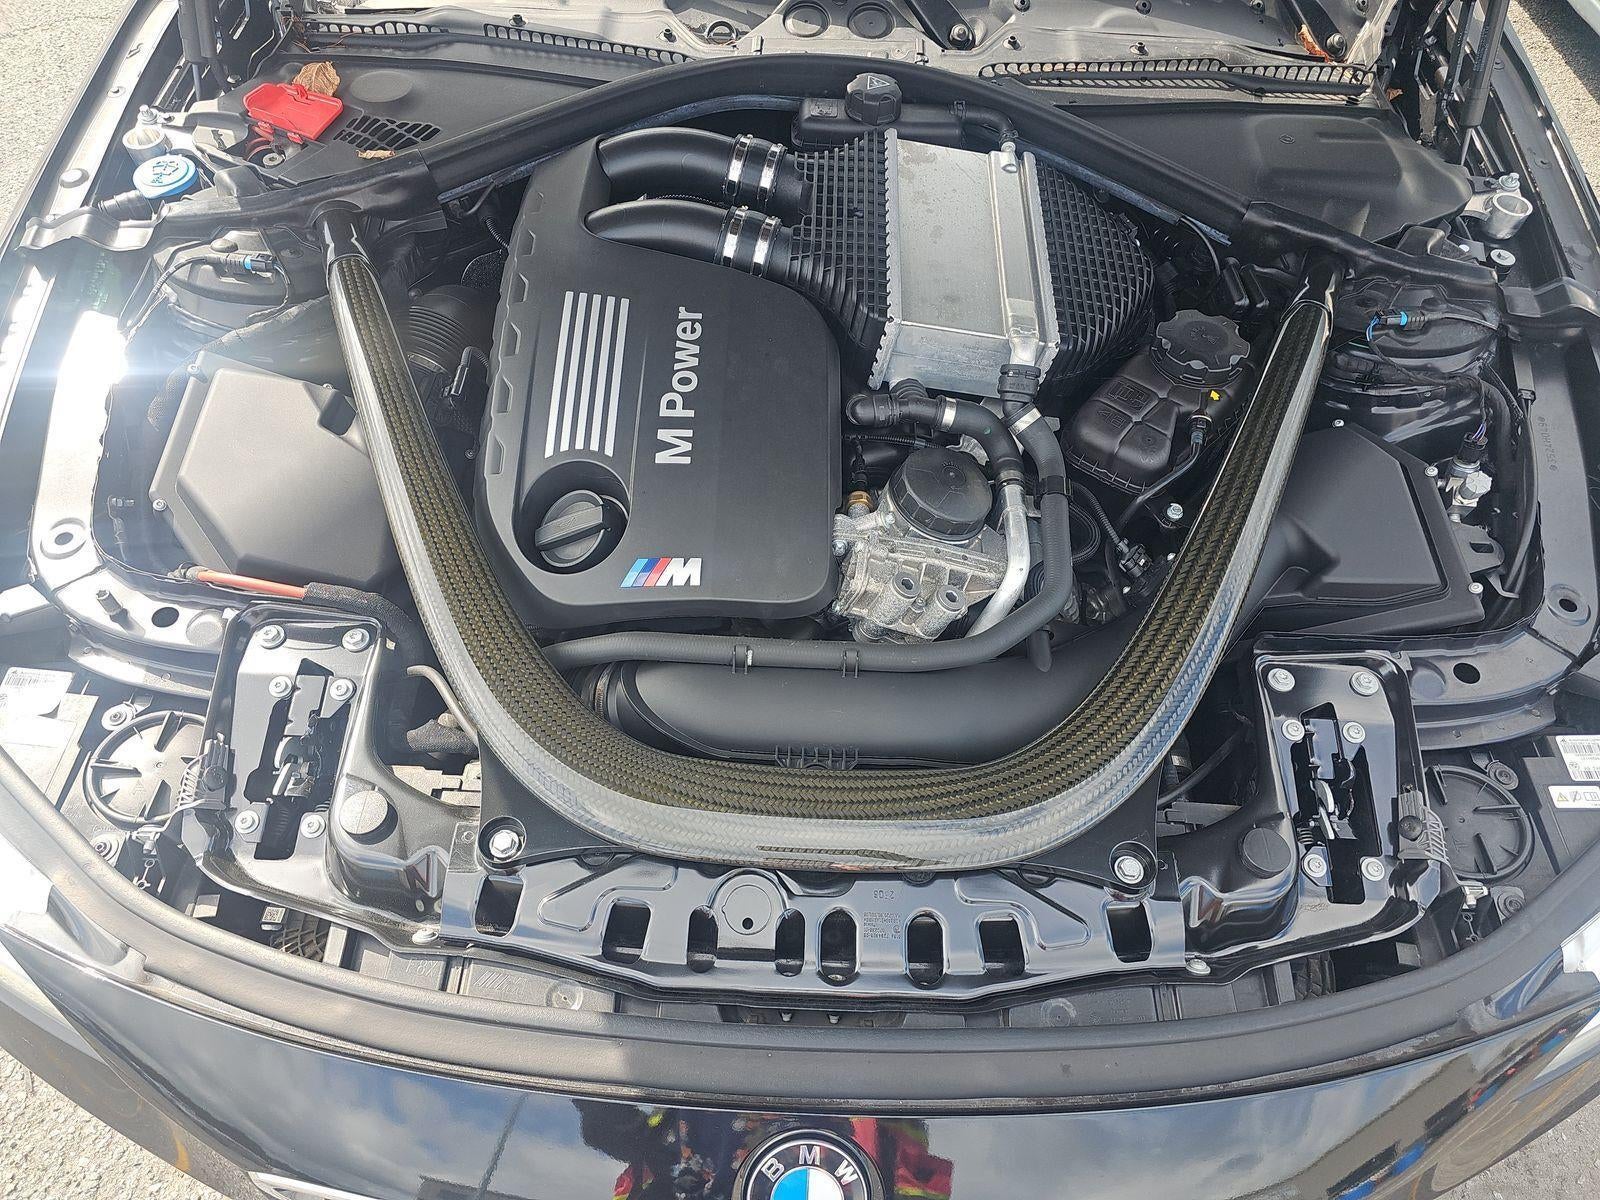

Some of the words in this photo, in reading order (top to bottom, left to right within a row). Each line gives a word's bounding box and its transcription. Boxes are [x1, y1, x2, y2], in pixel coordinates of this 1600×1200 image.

[659, 306, 703, 418] Power
[655, 429, 694, 464] M
[761, 1144, 859, 1186] BMW
